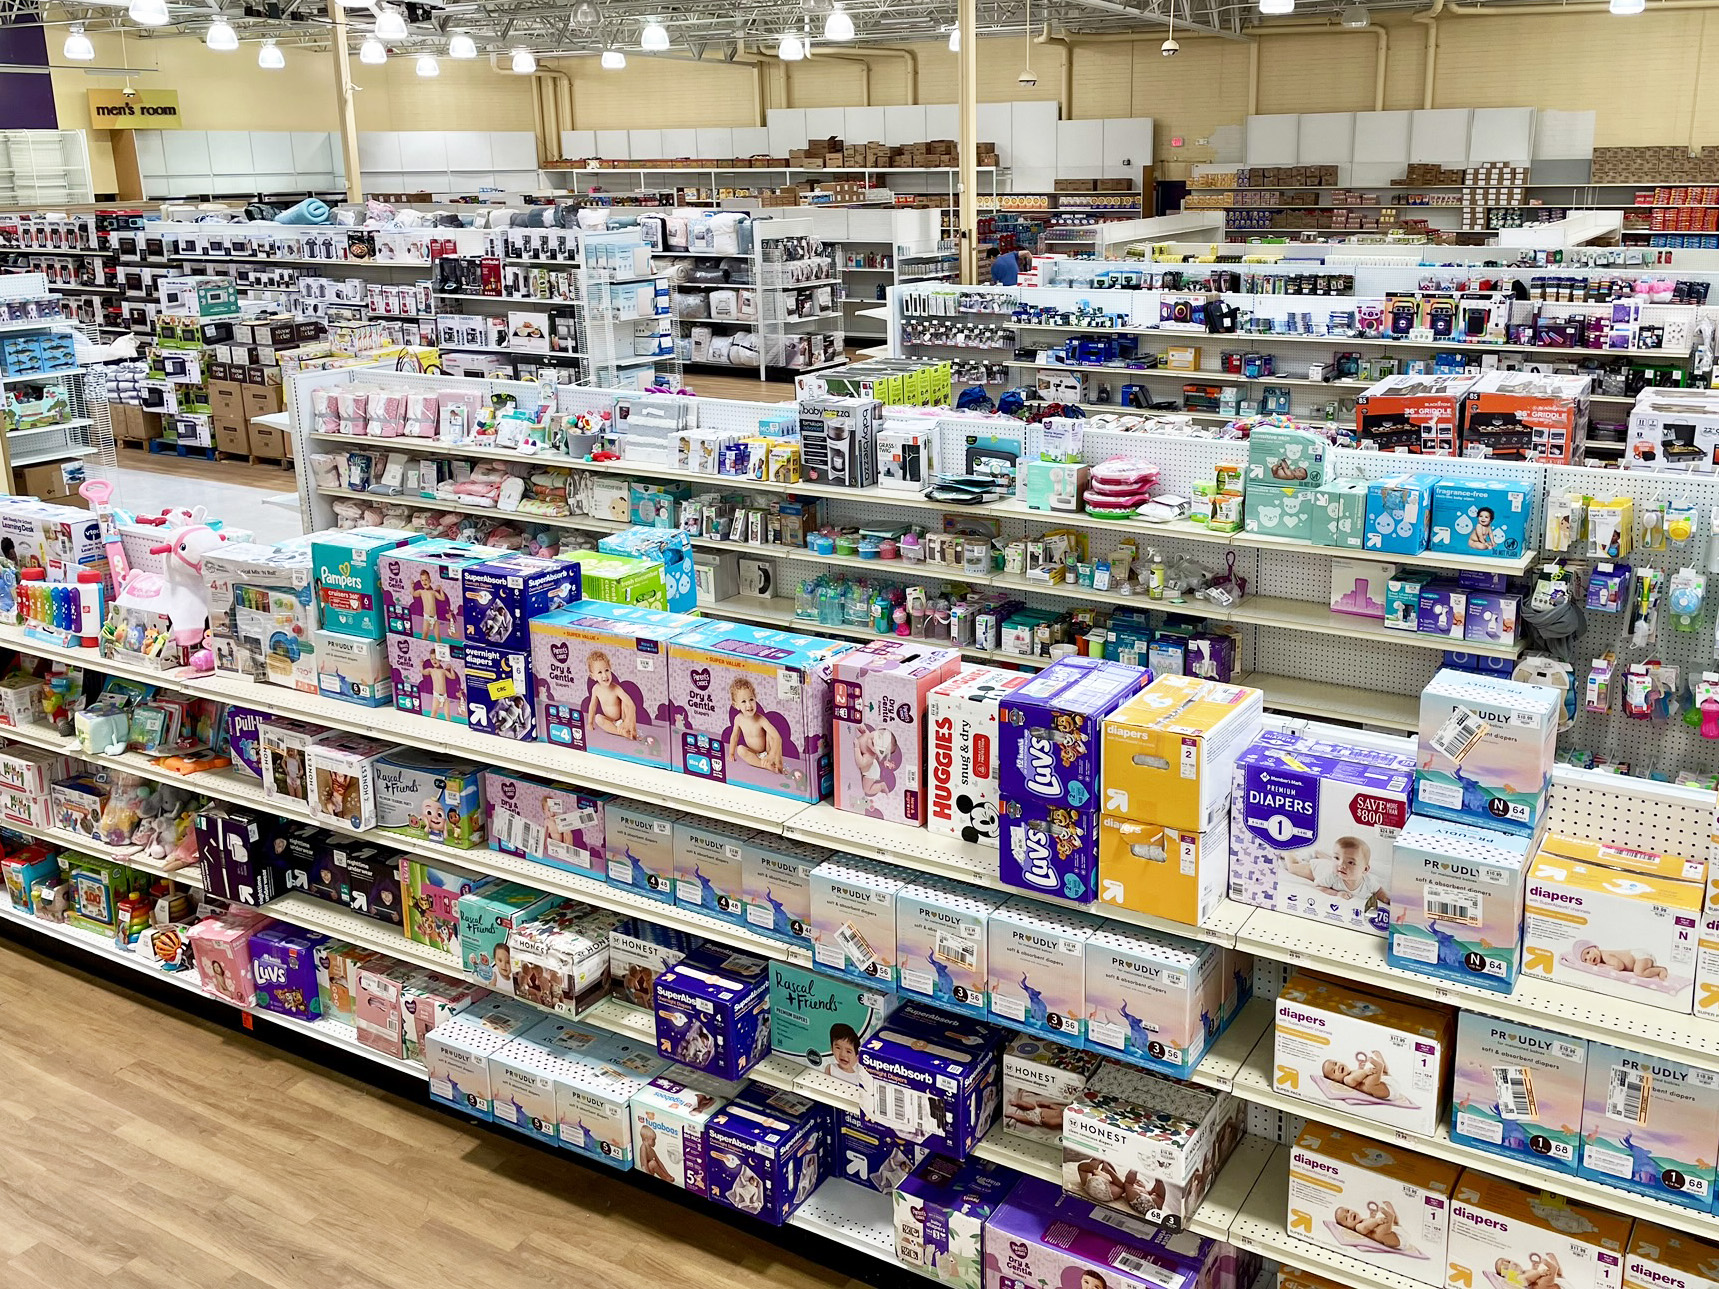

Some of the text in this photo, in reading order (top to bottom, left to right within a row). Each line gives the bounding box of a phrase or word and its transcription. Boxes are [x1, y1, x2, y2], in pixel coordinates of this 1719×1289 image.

[95, 102, 178, 118] men's room
[1436, 487, 1488, 499] fragrance-free
[2, 521, 35, 534] Learning Desk
[320, 566, 362, 589] Pampers
[464, 573, 507, 586] SuperAbsorb
[528, 571, 568, 588] SuperAbsorb
[465, 648, 500, 661] overnight
[466, 655, 492, 666] diapers
[550, 663, 572, 675] Dry &
[709, 657, 742, 668] SUPER VALUE
[549, 671, 575, 684] Gentle
[689, 690, 713, 703] Dry &
[687, 699, 715, 713] Gentle
[560, 728, 570, 741] 4
[1106, 724, 1149, 741] diapers
[1493, 732, 1518, 743] diapers
[960, 720, 972, 786] snug & dry
[1185, 750, 1192, 759] 2
[308, 752, 316, 787] HONEST
[698, 757, 708, 773] 4
[932, 716, 953, 820] HUGGIES
[1027, 736, 1062, 797] Luvs
[376, 767, 404, 784] Rascal
[1266, 784, 1297, 796] PREMIUM
[1249, 791, 1314, 816] DIAPERS
[1356, 796, 1387, 813] SAVE
[1493, 799, 1504, 810] N
[1512, 806, 1525, 815] 64
[1356, 809, 1384, 825] $800
[1386, 808, 1398, 816] THAN
[1277, 820, 1284, 836] 1
[1023, 829, 1059, 888] Luvs
[1185, 848, 1191, 857] 2
[1434, 880, 1466, 892] absorbent
[1529, 885, 1583, 907] diapers
[460, 909, 483, 926] Rascal
[1678, 931, 1689, 941] N
[621, 938, 659, 957] HONEST
[1470, 953, 1480, 965] N
[1489, 960, 1502, 970] 64
[252, 963, 287, 985] Luvs
[879, 968, 889, 976] 56
[776, 971, 815, 997] Rascal
[958, 987, 980, 1002] 3 56
[716, 1013, 722, 1022] 4
[1051, 1014, 1076, 1030] 3 56
[1279, 1007, 1326, 1027] diapers
[1153, 1043, 1178, 1059] 3 56
[1501, 1051, 1534, 1063] absorbent
[1534, 1058, 1560, 1070] diapers
[862, 1054, 933, 1084] SuperAbsorb
[1015, 1066, 1056, 1084] HONEST
[1669, 1090, 1696, 1102] diapers
[1080, 1121, 1127, 1145] HONEST
[1554, 1144, 1568, 1154] 68
[1293, 1153, 1339, 1176] diapers
[686, 1170, 695, 1184] 5
[1688, 1178, 1703, 1189] 68
[1150, 1210, 1161, 1219] 68
[1168, 1216, 1175, 1225] 3
[1453, 1206, 1509, 1233] diapers
[1008, 1255, 1022, 1266] Dry
[1006, 1262, 1033, 1277] Gentle
[1630, 1262, 1686, 1289] diapers
